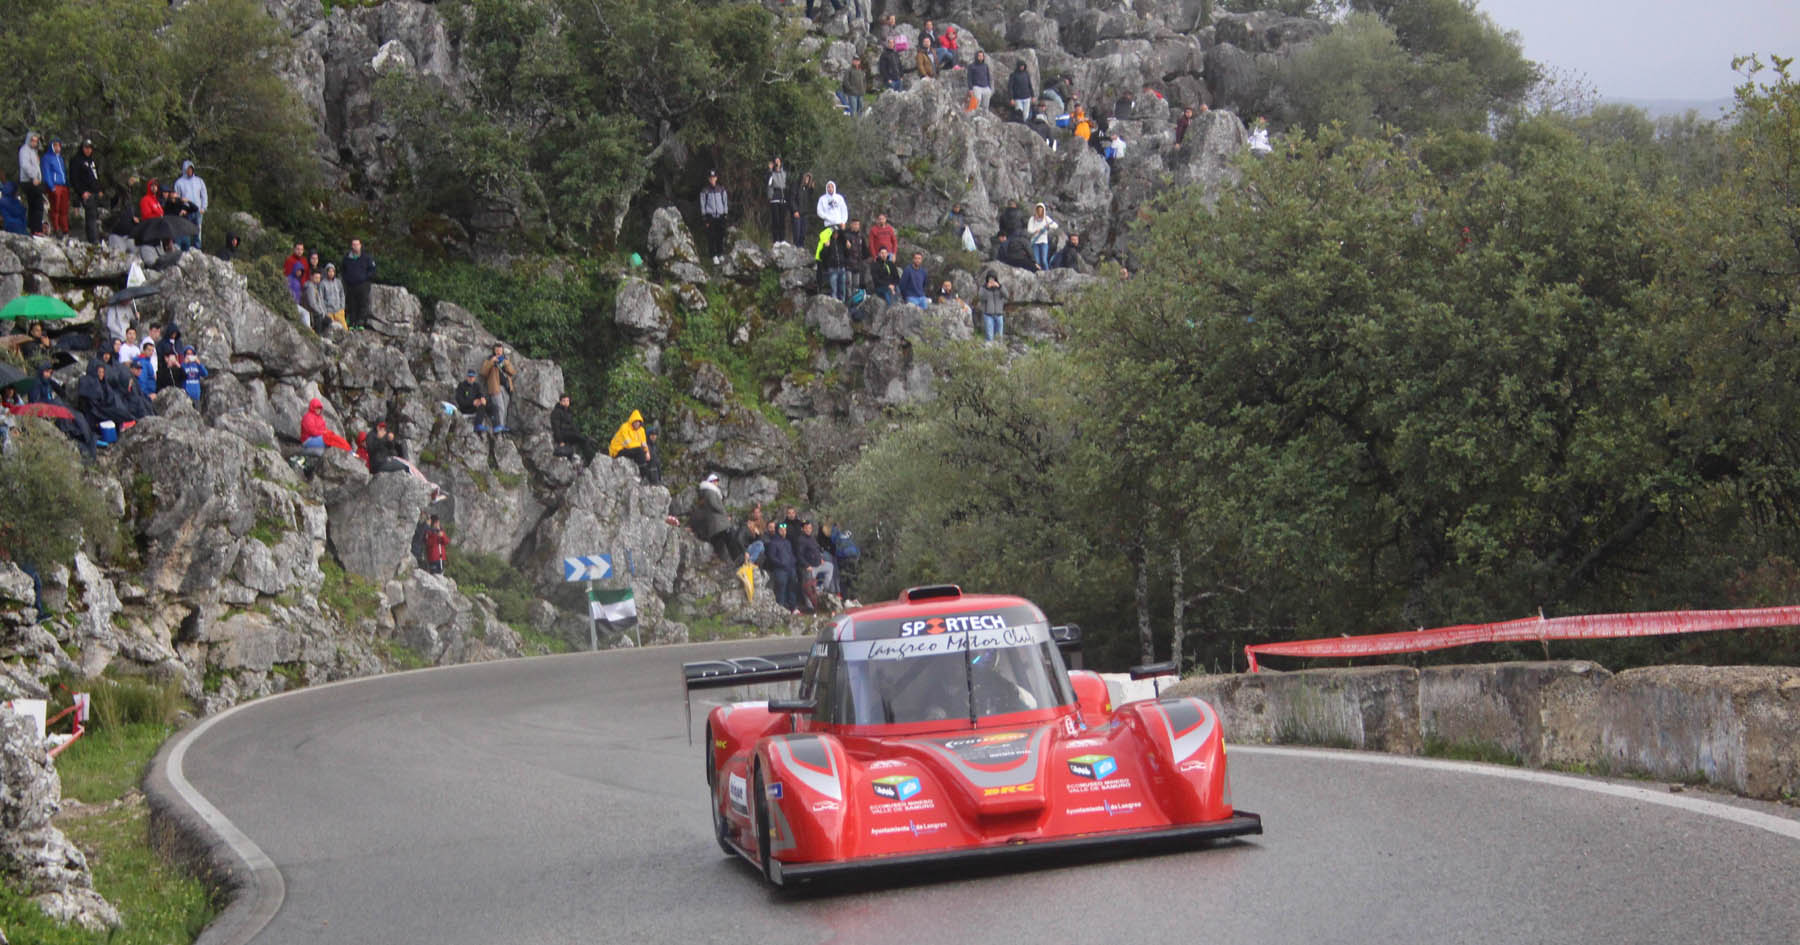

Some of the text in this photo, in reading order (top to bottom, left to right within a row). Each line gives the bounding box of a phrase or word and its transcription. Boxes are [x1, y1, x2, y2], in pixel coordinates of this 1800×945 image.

[901, 615, 1006, 637] SPORTECH
[867, 640, 937, 659] Langreo
[946, 635, 1001, 651] Motor
